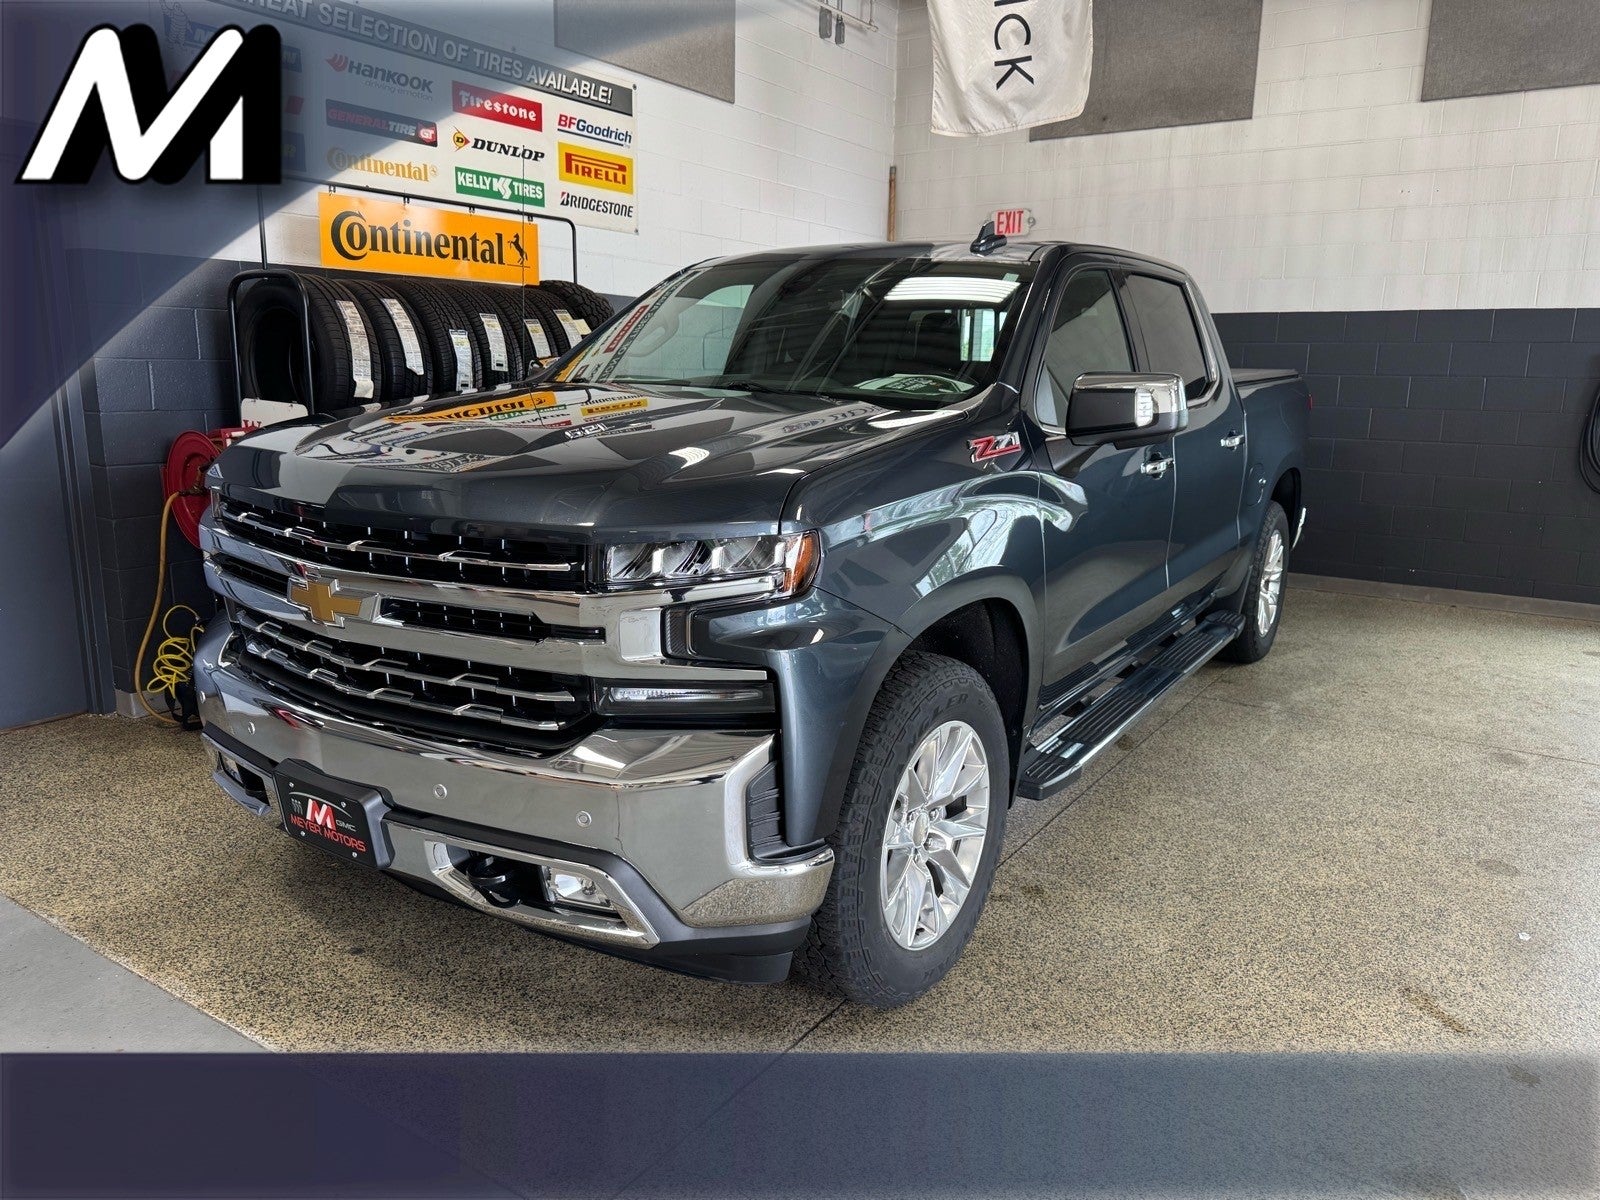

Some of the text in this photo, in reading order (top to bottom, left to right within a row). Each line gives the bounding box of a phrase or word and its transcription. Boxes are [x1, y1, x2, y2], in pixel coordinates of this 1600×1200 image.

[318, 3, 438, 55] SELECTION
[443, 39, 469, 62] OF
[473, 49, 523, 79] TIRES
[525, 65, 612, 105] AVAILABLE!
[459, 90, 536, 121] Firestone
[558, 114, 632, 143] BFGoodrich
[327, 144, 429, 182] Continental
[471, 138, 545, 162] DUNLOP
[565, 152, 627, 185] PIRELLI
[457, 171, 491, 191] KELLY
[512, 181, 543, 199] TIRES
[560, 191, 634, 218] BRIDGESTONE
[330, 210, 506, 266] Continental
[996, 210, 1024, 236] EXIT
[290, 813, 367, 852] MEYER MOTORS
[336, 819, 357, 833] GMC
